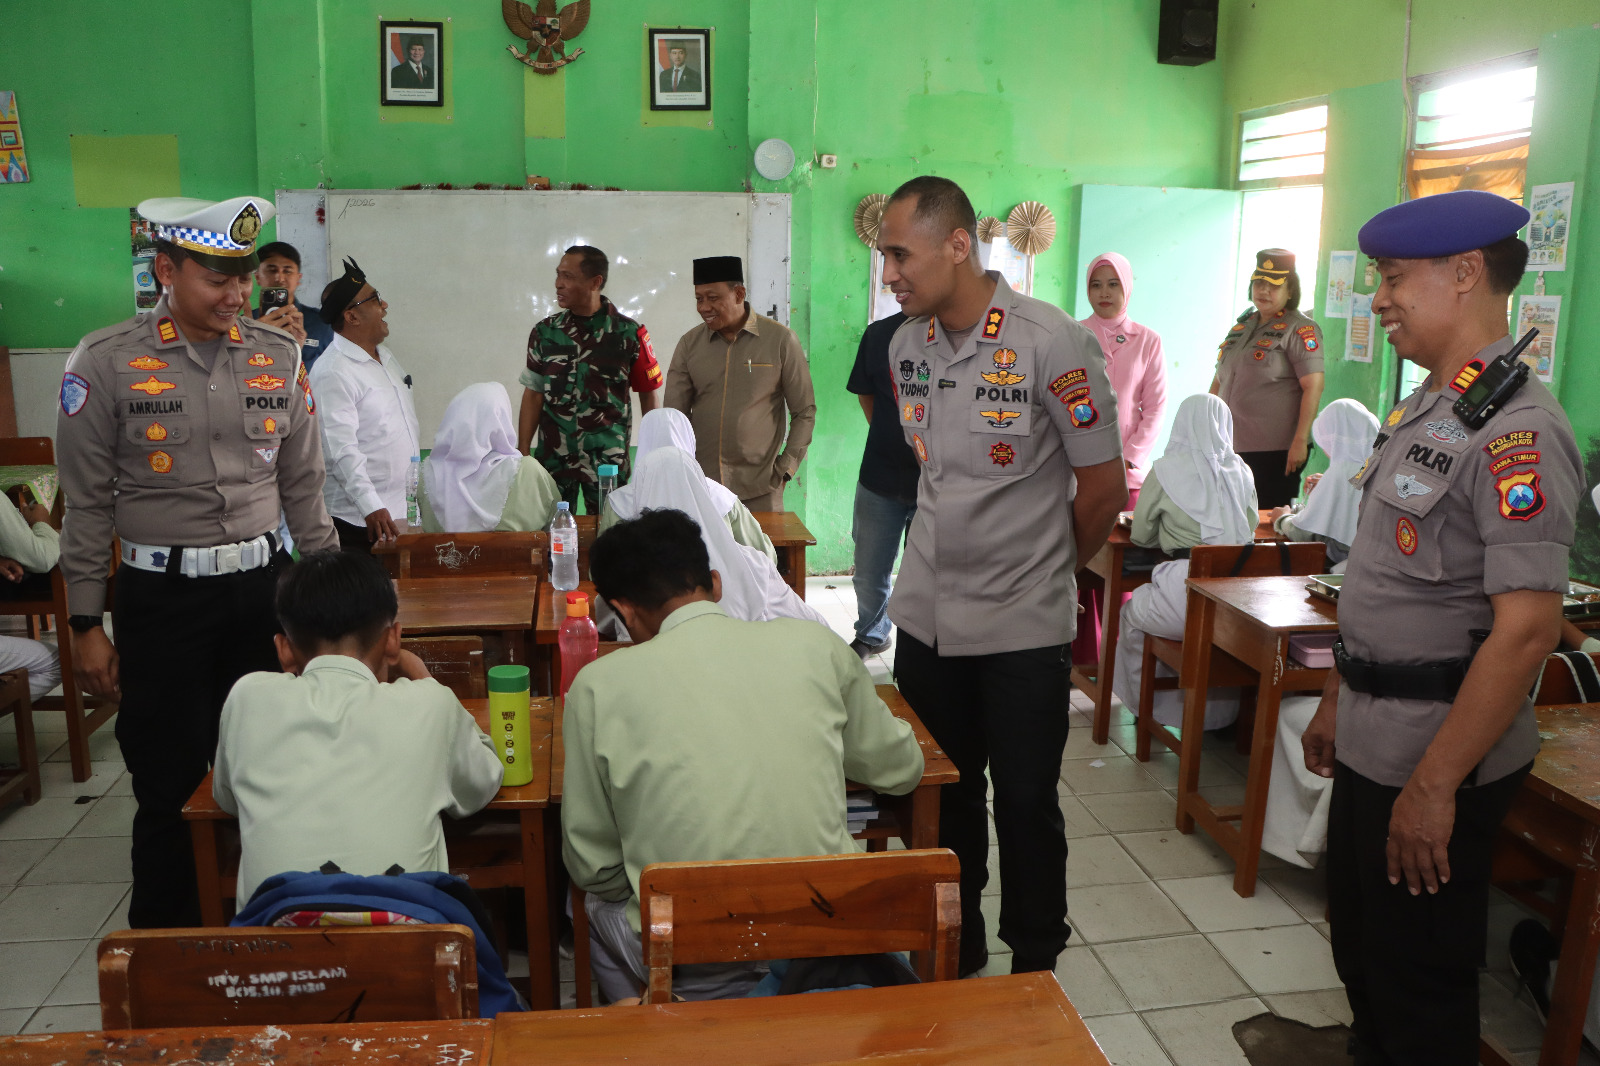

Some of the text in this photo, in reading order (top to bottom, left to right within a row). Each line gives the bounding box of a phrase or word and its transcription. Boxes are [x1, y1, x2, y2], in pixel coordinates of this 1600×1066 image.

[1053, 370, 1083, 389] POLRES
[900, 382, 929, 397] YUDHO
[975, 386, 1028, 403] POLRI
[129, 401, 183, 414] AMRULLAH
[245, 396, 289, 410] POLRI
[1488, 431, 1533, 450] POLRES
[1405, 443, 1454, 475] POLRI
[1493, 454, 1537, 471] JAWA TIMUR
[249, 971, 288, 985] SMP
[292, 967, 347, 981] ISLAM
